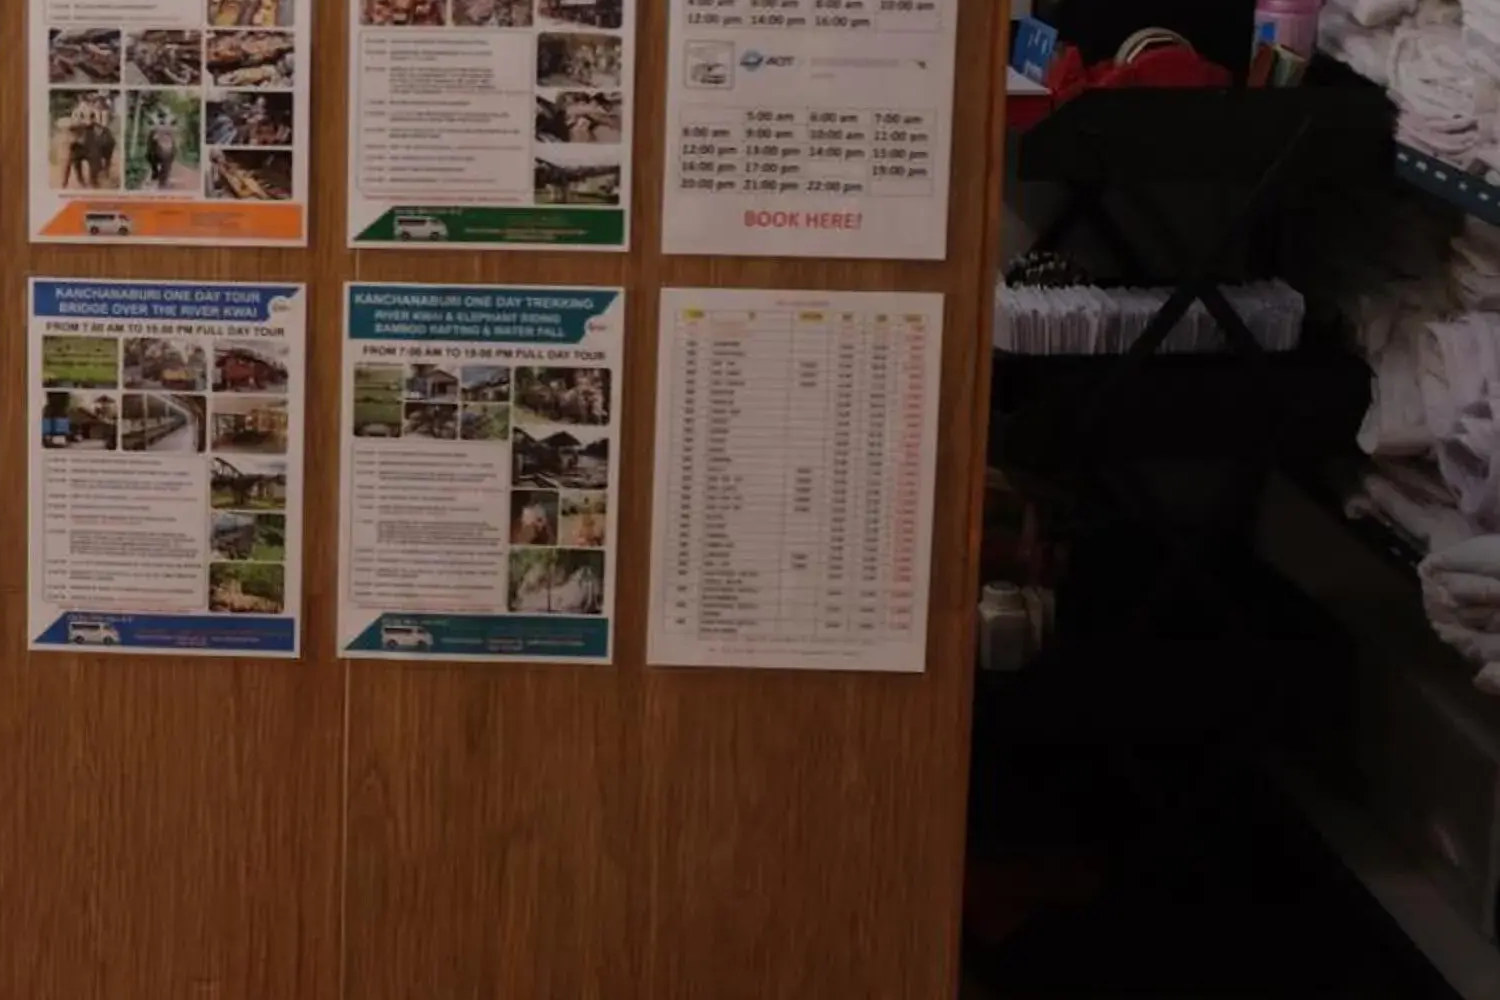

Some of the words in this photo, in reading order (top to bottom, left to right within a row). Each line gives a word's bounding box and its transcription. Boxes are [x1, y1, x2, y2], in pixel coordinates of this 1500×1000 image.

[743, 210, 801, 228] BOOK
[805, 212, 863, 230] HERE!
[164, 289, 191, 302] ONE
[194, 290, 221, 303] DAY
[225, 291, 261, 303] TOUR
[464, 295, 492, 309] ONE
[495, 296, 523, 309] DAY
[59, 302, 108, 315] BRIDGE
[112, 303, 148, 316] OVER
[152, 304, 177, 316] THE
[181, 304, 219, 317] RIVER
[223, 305, 257, 318] KWAI
[128, 323, 142, 333] TO
[177, 325, 193, 335] PM
[227, 326, 250, 336] DAY
[254, 326, 285, 337] TOUR
